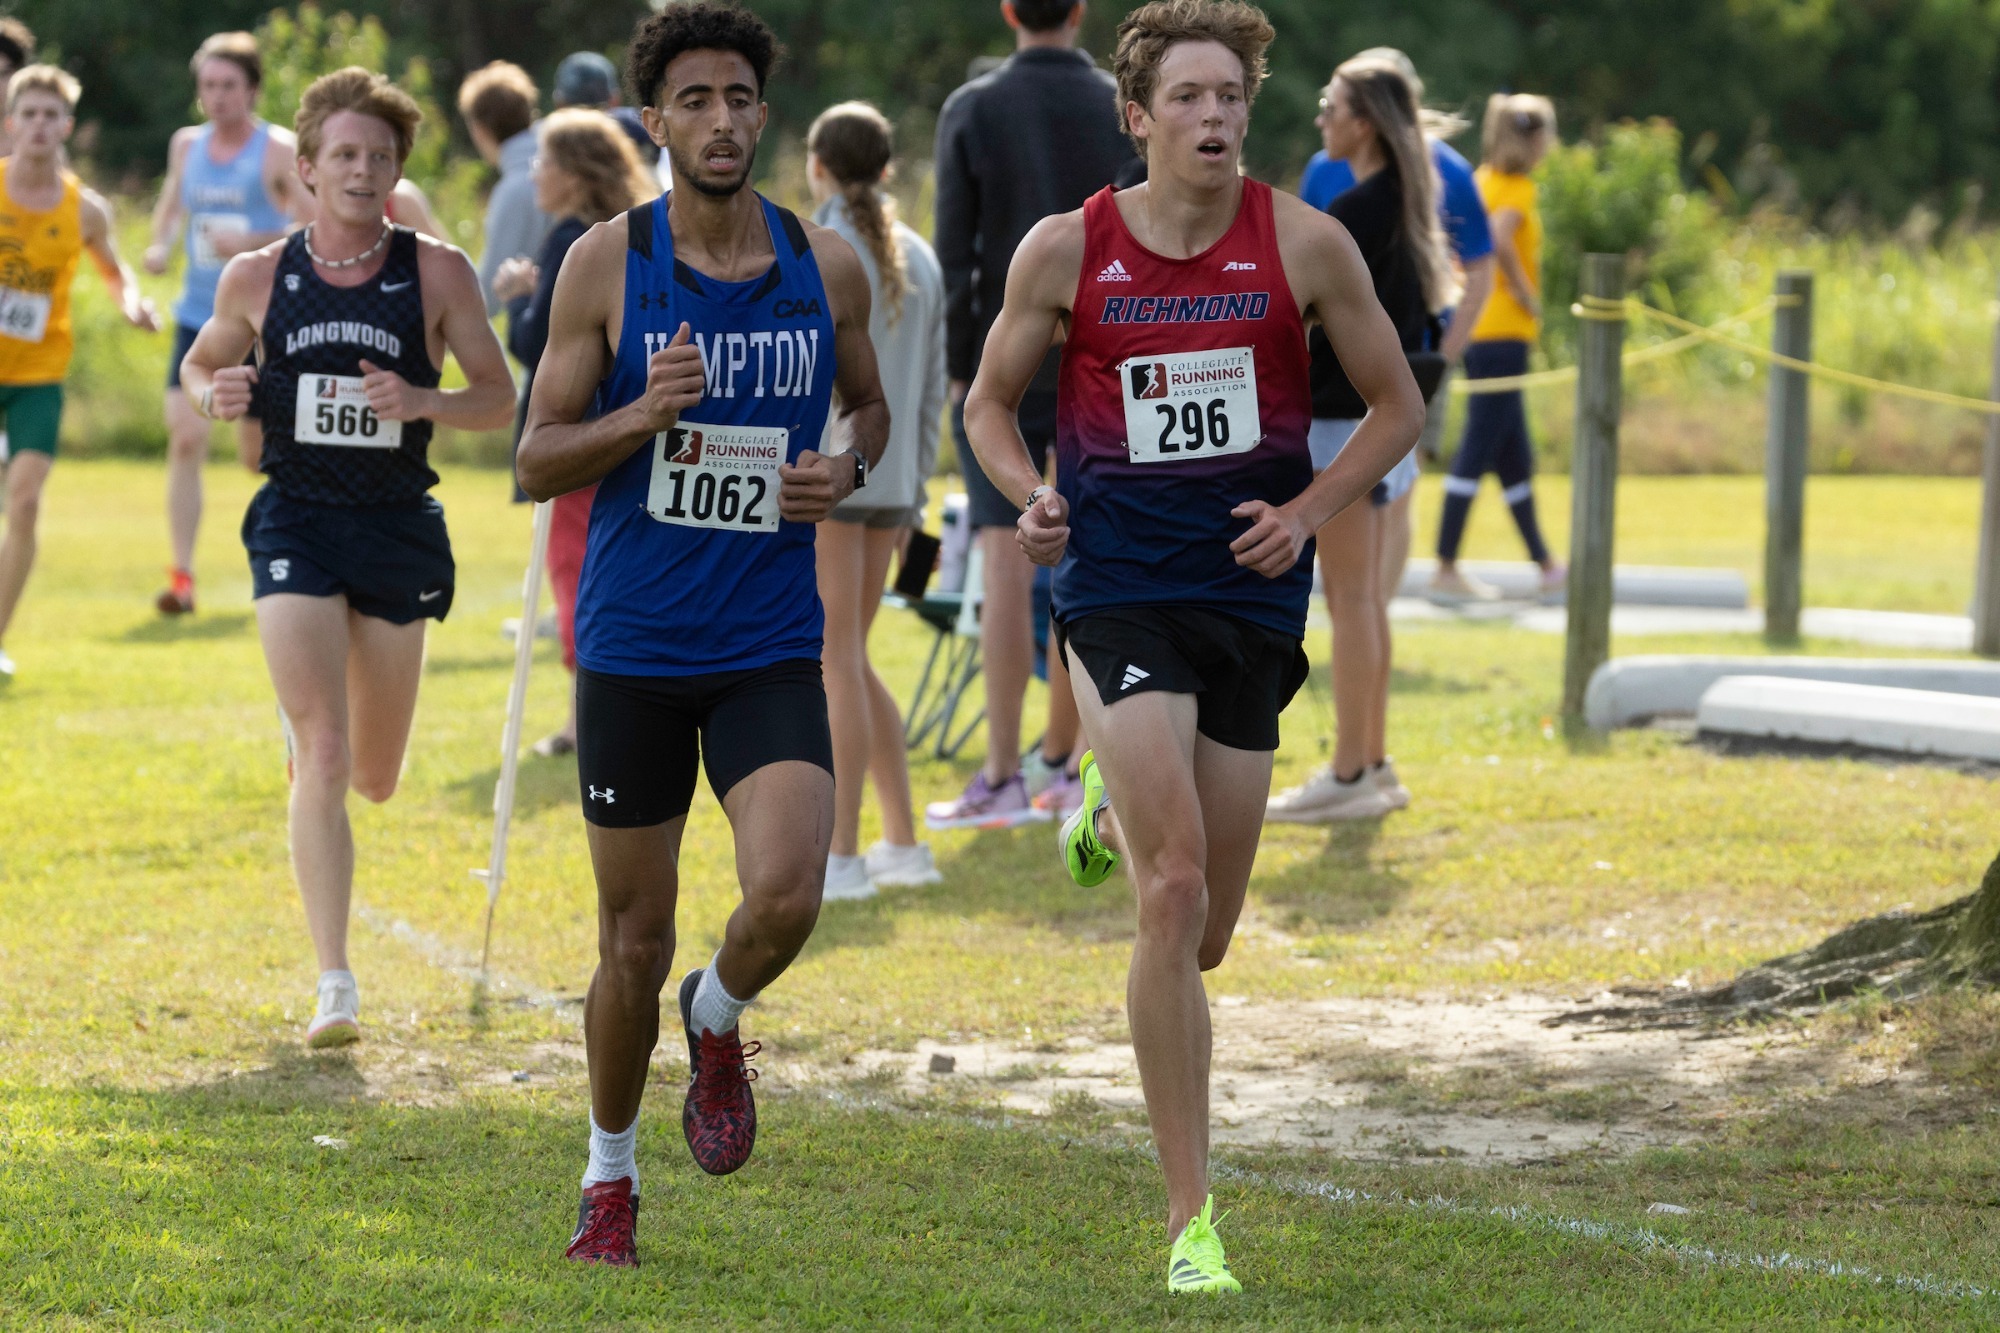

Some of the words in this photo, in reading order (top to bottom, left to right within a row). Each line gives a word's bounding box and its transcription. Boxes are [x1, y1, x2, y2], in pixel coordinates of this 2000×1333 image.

[1096, 273, 1132, 282] adidas
[773, 299, 822, 319] CAA
[1098, 292, 1270, 324] RICHMOND
[286, 321, 401, 358] LONGWOOD
[644, 329, 819, 398] MPTON
[1170, 356, 1245, 372] COLLEGIATE
[1171, 366, 1246, 386] RUNNING
[1173, 383, 1248, 397] ASSOCIATION
[315, 403, 379, 437] 566
[1155, 398, 1230, 454] 296
[707, 433, 779, 446] COLLEGIATE
[705, 444, 777, 459] RUNNING
[704, 460, 777, 470] ASSOCIATION
[664, 469, 767, 525] 1062
